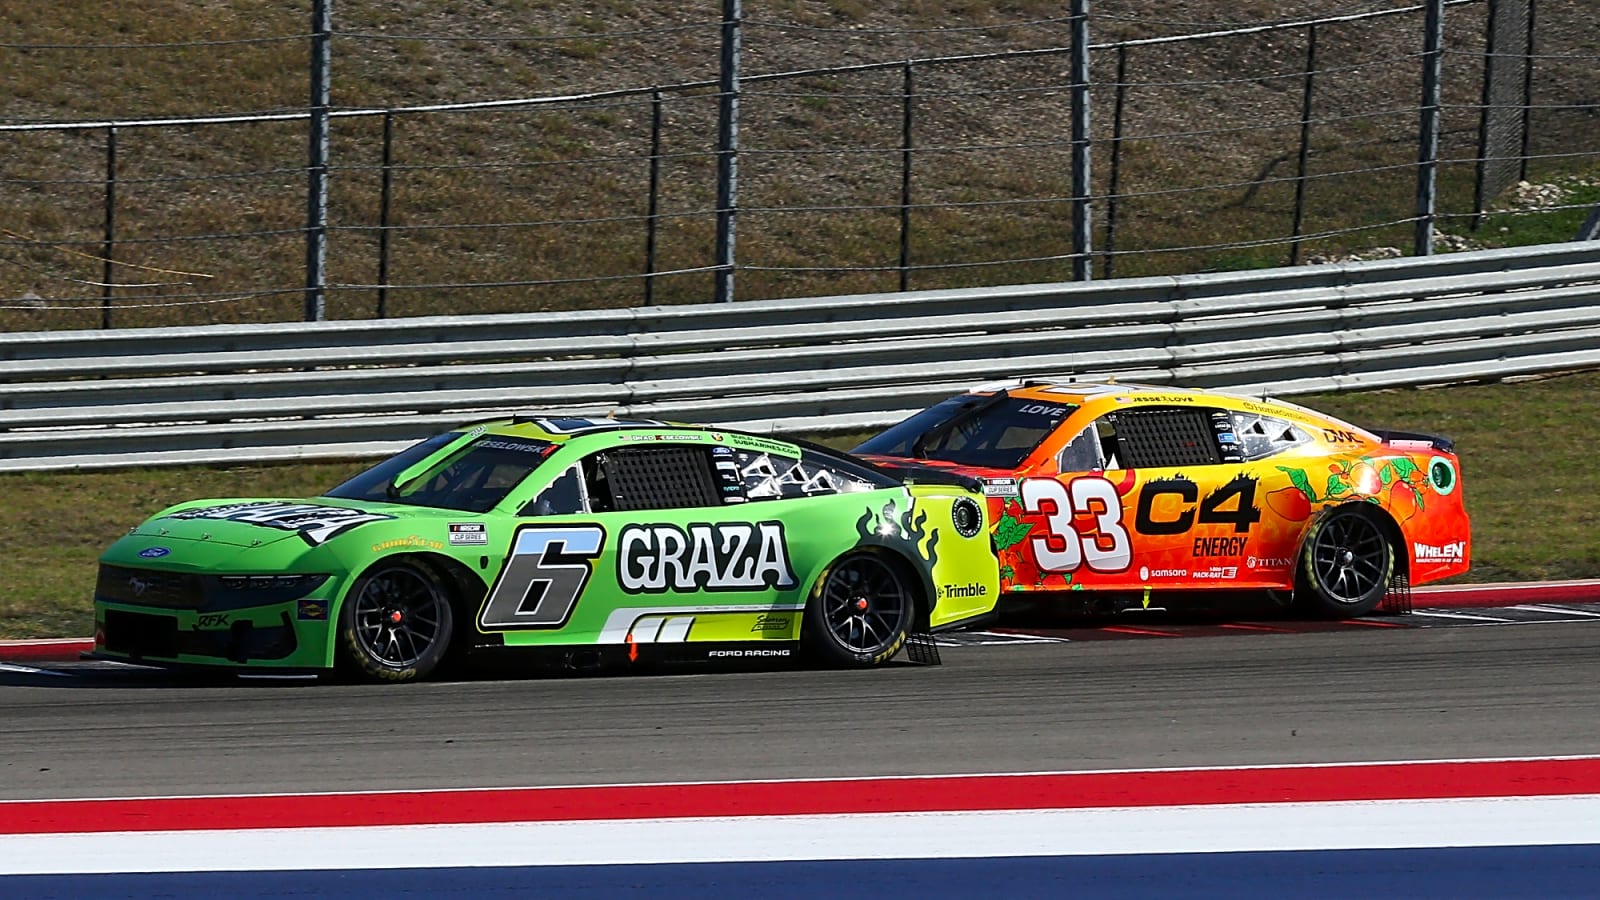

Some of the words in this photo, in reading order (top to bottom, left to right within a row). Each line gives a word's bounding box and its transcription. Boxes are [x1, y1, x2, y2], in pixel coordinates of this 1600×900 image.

[1018, 403, 1066, 416] LOVE
[733, 438, 800, 456] SUBMARINES.COM
[1135, 471, 1261, 535] C4
[1021, 477, 1133, 574] 33
[1192, 536, 1248, 557] ENERGY
[1413, 541, 1464, 558] WHELEN
[618, 522, 797, 592] GRAZA
[1257, 558, 1292, 567] TITAN
[478, 523, 607, 630] 6
[1151, 568, 1187, 577] samsara
[943, 582, 986, 598] Trimble
[744, 649, 791, 657] RACING
